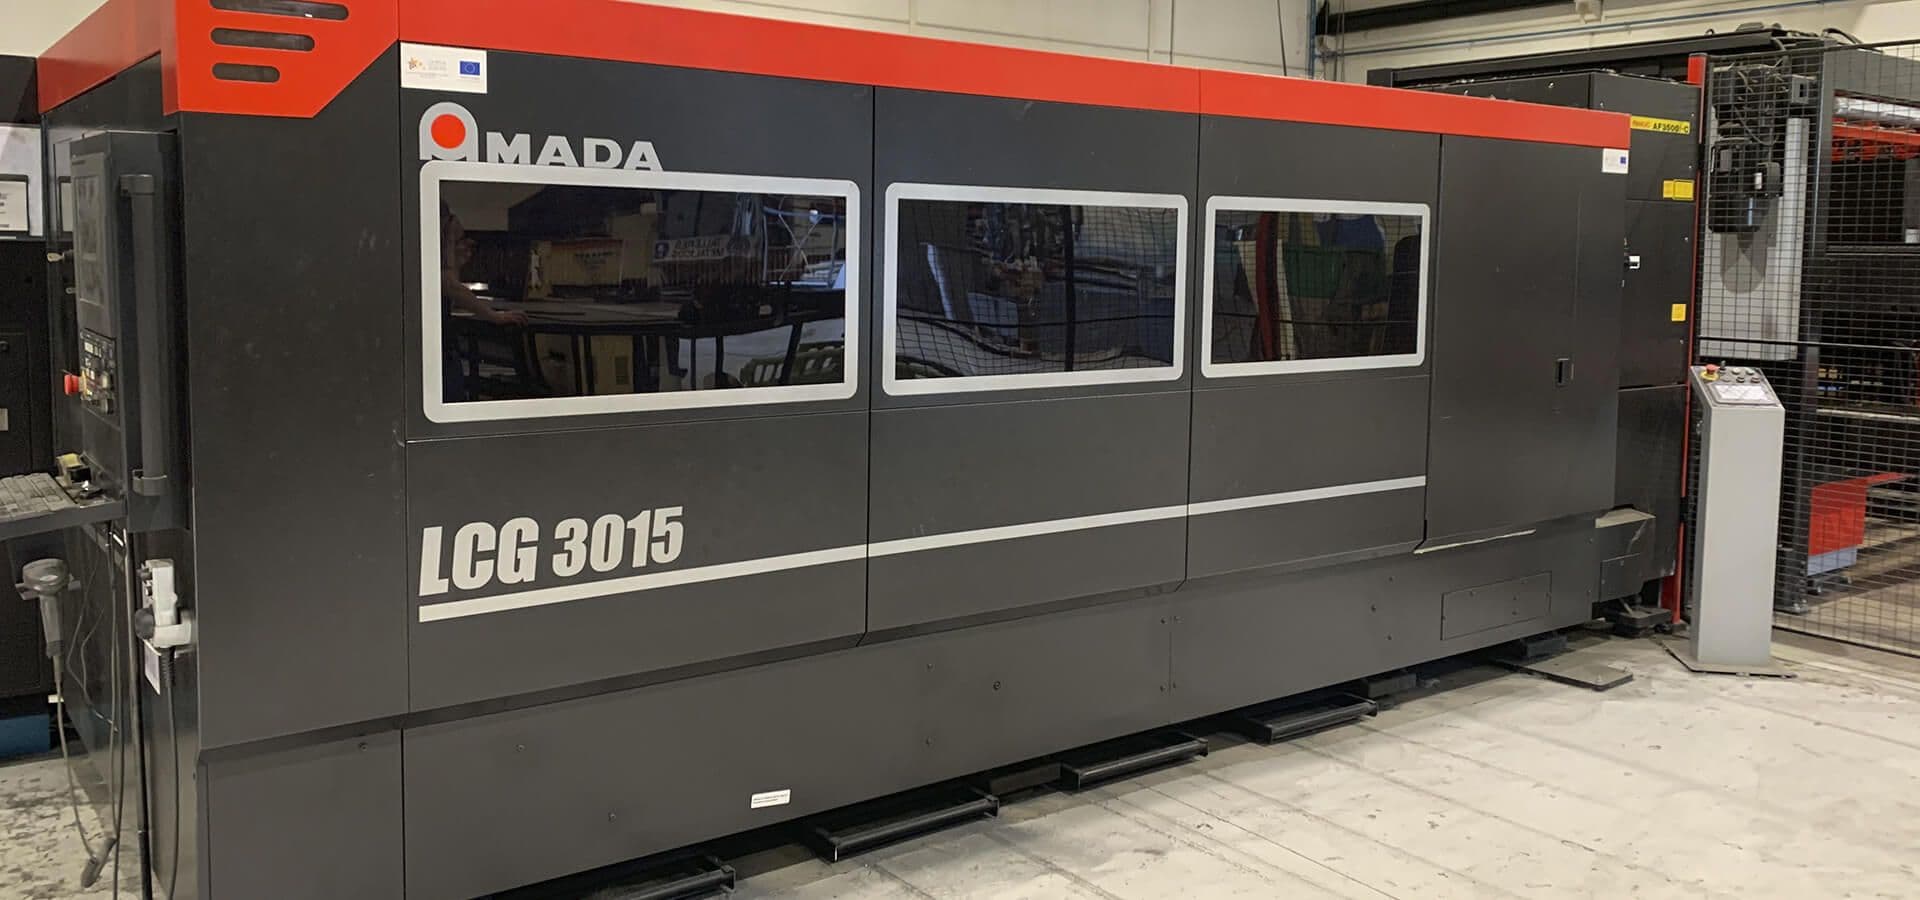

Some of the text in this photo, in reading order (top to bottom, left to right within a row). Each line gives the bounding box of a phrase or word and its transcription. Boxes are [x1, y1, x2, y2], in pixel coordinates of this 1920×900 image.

[419, 102, 664, 170] AMADA
[418, 506, 684, 597] LCG 3015
